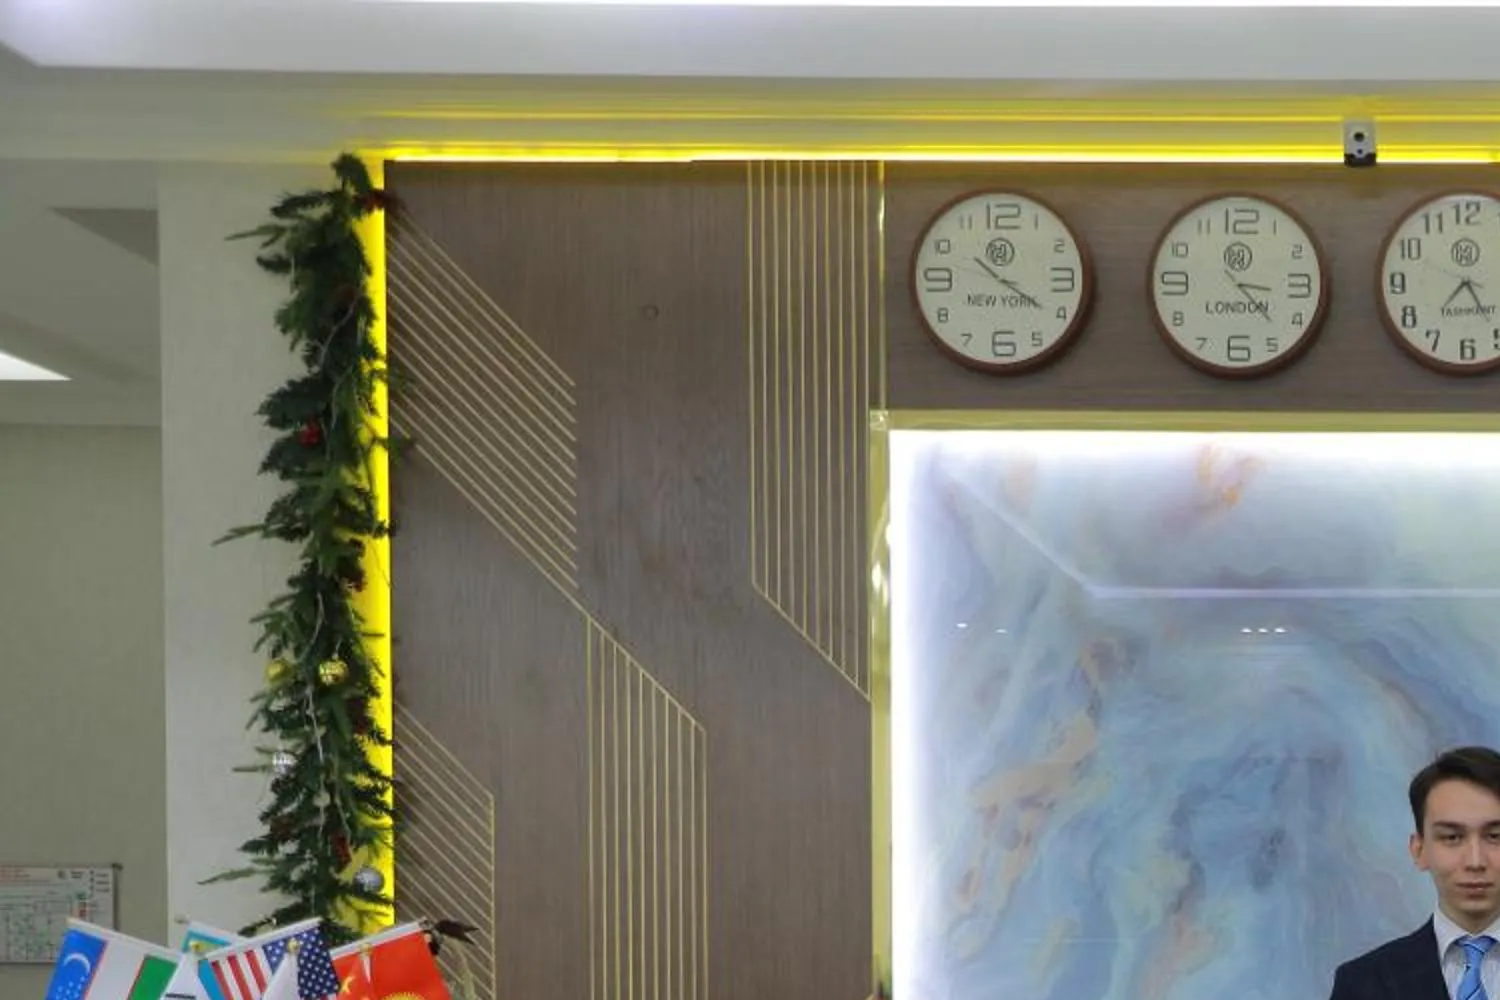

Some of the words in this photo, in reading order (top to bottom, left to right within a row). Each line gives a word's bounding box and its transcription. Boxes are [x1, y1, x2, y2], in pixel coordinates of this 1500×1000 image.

[959, 214, 973, 230] 11
[986, 202, 1021, 230] 12
[1033, 213, 1039, 230] 1
[1225, 208, 1260, 234] 12
[1453, 201, 1481, 226] 12
[1198, 218, 1211, 235] 11
[1272, 220, 1277, 235] 1
[1422, 211, 1443, 234] 11
[934, 239, 950, 254] 10
[1053, 239, 1065, 253] 2
[1172, 242, 1189, 258] 10
[1292, 244, 1303, 259] 2
[1400, 237, 1421, 260] 10
[924, 267, 953, 292] 9
[1051, 267, 1075, 292] 3
[1161, 271, 1189, 296] 9
[1288, 273, 1311, 298] 3
[1390, 272, 1406, 295] 9
[967, 294, 997, 306] NEW
[1000, 294, 1038, 308] YORK
[1205, 301, 1269, 314] LONDON
[937, 308, 949, 323] 8
[1056, 307, 1067, 320] 4
[1173, 311, 1184, 326] 8
[1291, 312, 1303, 326] 4
[1402, 305, 1417, 329] 8
[961, 333, 973, 346] 7
[992, 331, 1017, 357] 6
[1032, 332, 1043, 347] 5
[1196, 337, 1208, 350] 7
[1266, 337, 1278, 352] 5
[1425, 329, 1440, 351] 7
[1228, 335, 1251, 362] 6
[1460, 339, 1476, 361] 6
